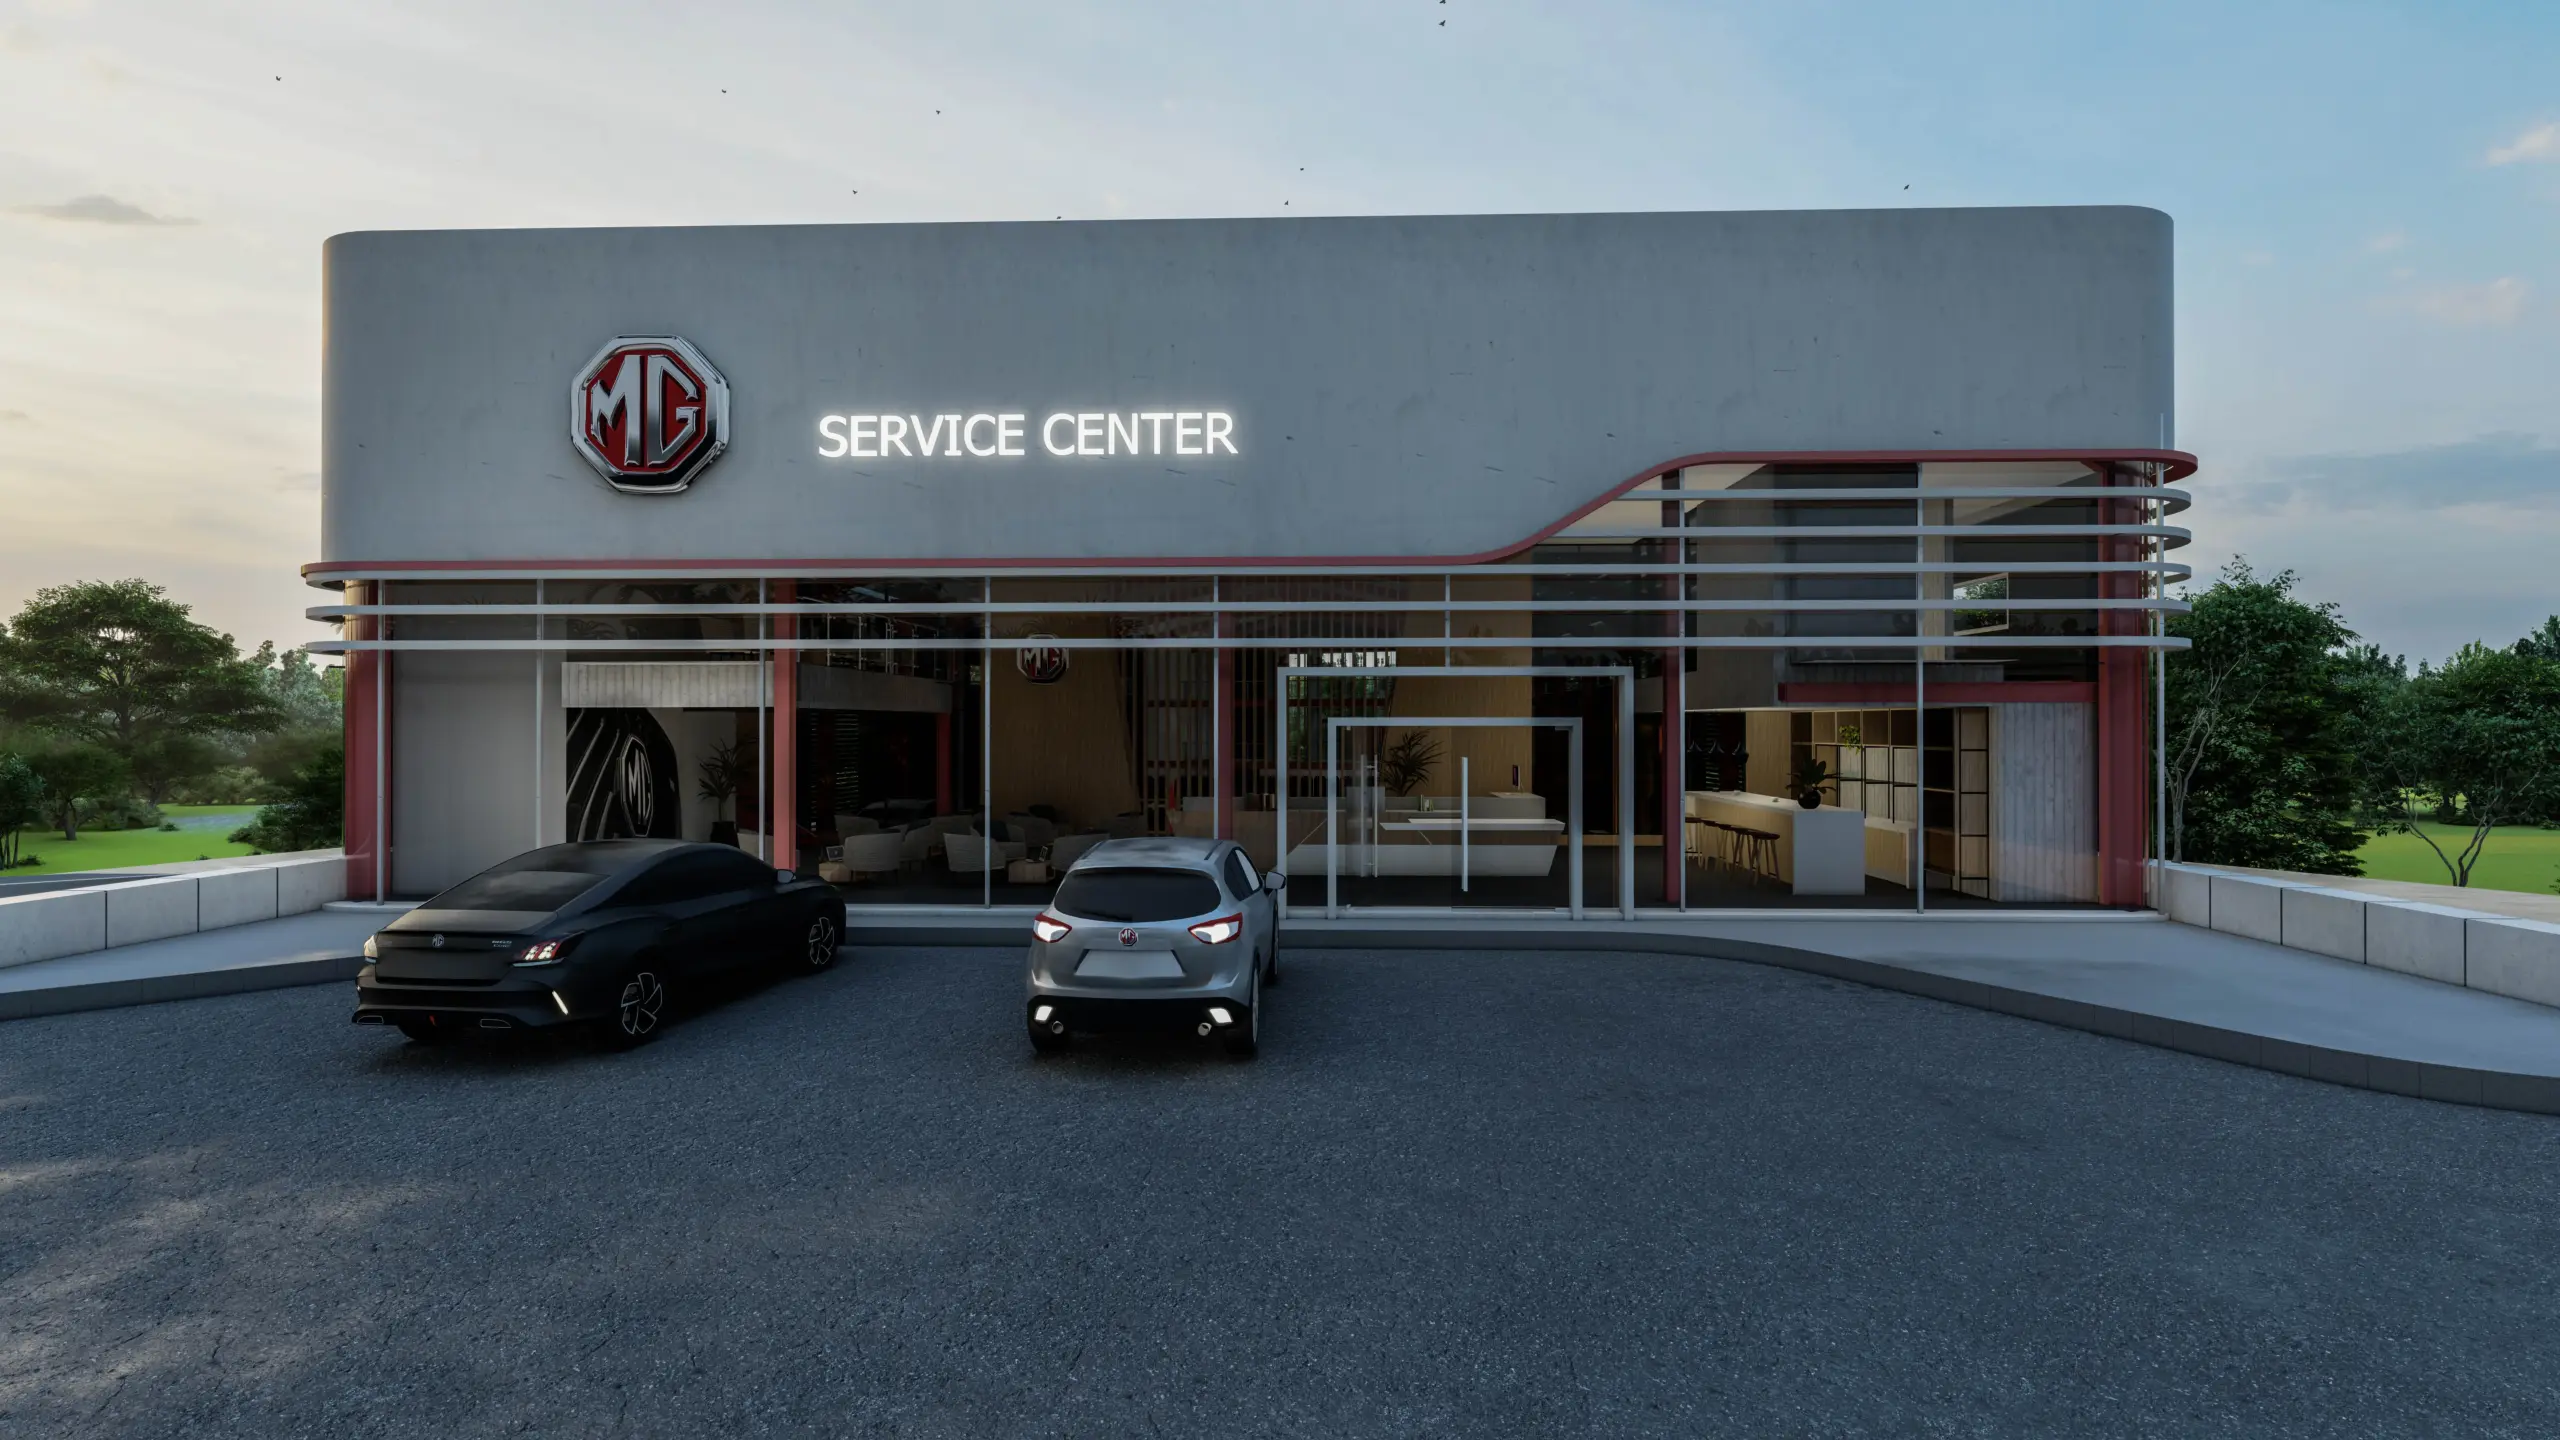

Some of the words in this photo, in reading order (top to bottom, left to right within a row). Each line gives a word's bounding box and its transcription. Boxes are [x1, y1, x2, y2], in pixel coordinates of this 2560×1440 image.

[591, 355, 701, 467] MG
[818, 413, 1025, 458] SERVICE
[1043, 412, 1239, 456] CENTER
[1023, 646, 1061, 677] MG
[627, 748, 651, 825] MG
[431, 933, 445, 949] MG
[1120, 928, 1137, 945] MG
